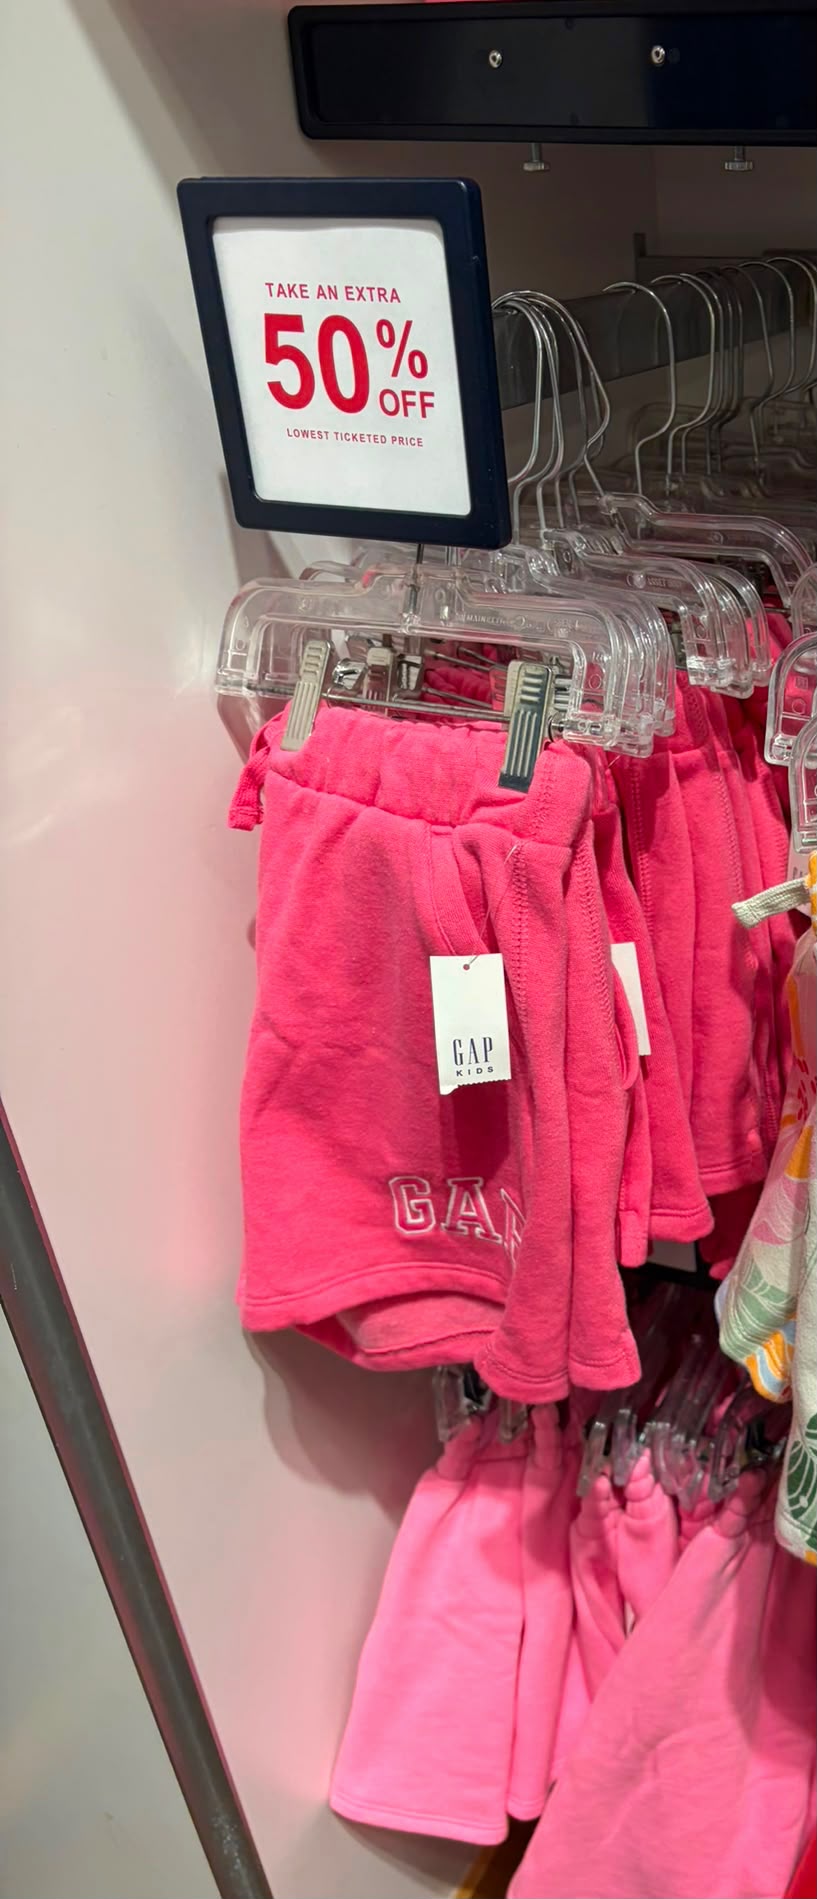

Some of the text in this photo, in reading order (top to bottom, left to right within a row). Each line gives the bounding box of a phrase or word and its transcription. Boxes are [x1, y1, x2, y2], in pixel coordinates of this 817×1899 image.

[264, 282, 401, 304] TAKE AN EXTRA
[264, 312, 429, 414] 50%
[378, 388, 435, 419] OFF
[286, 428, 424, 448] LOWEST TICKETED PRICE
[452, 1036, 493, 1067] GAP
[455, 1066, 494, 1077] KIDS
